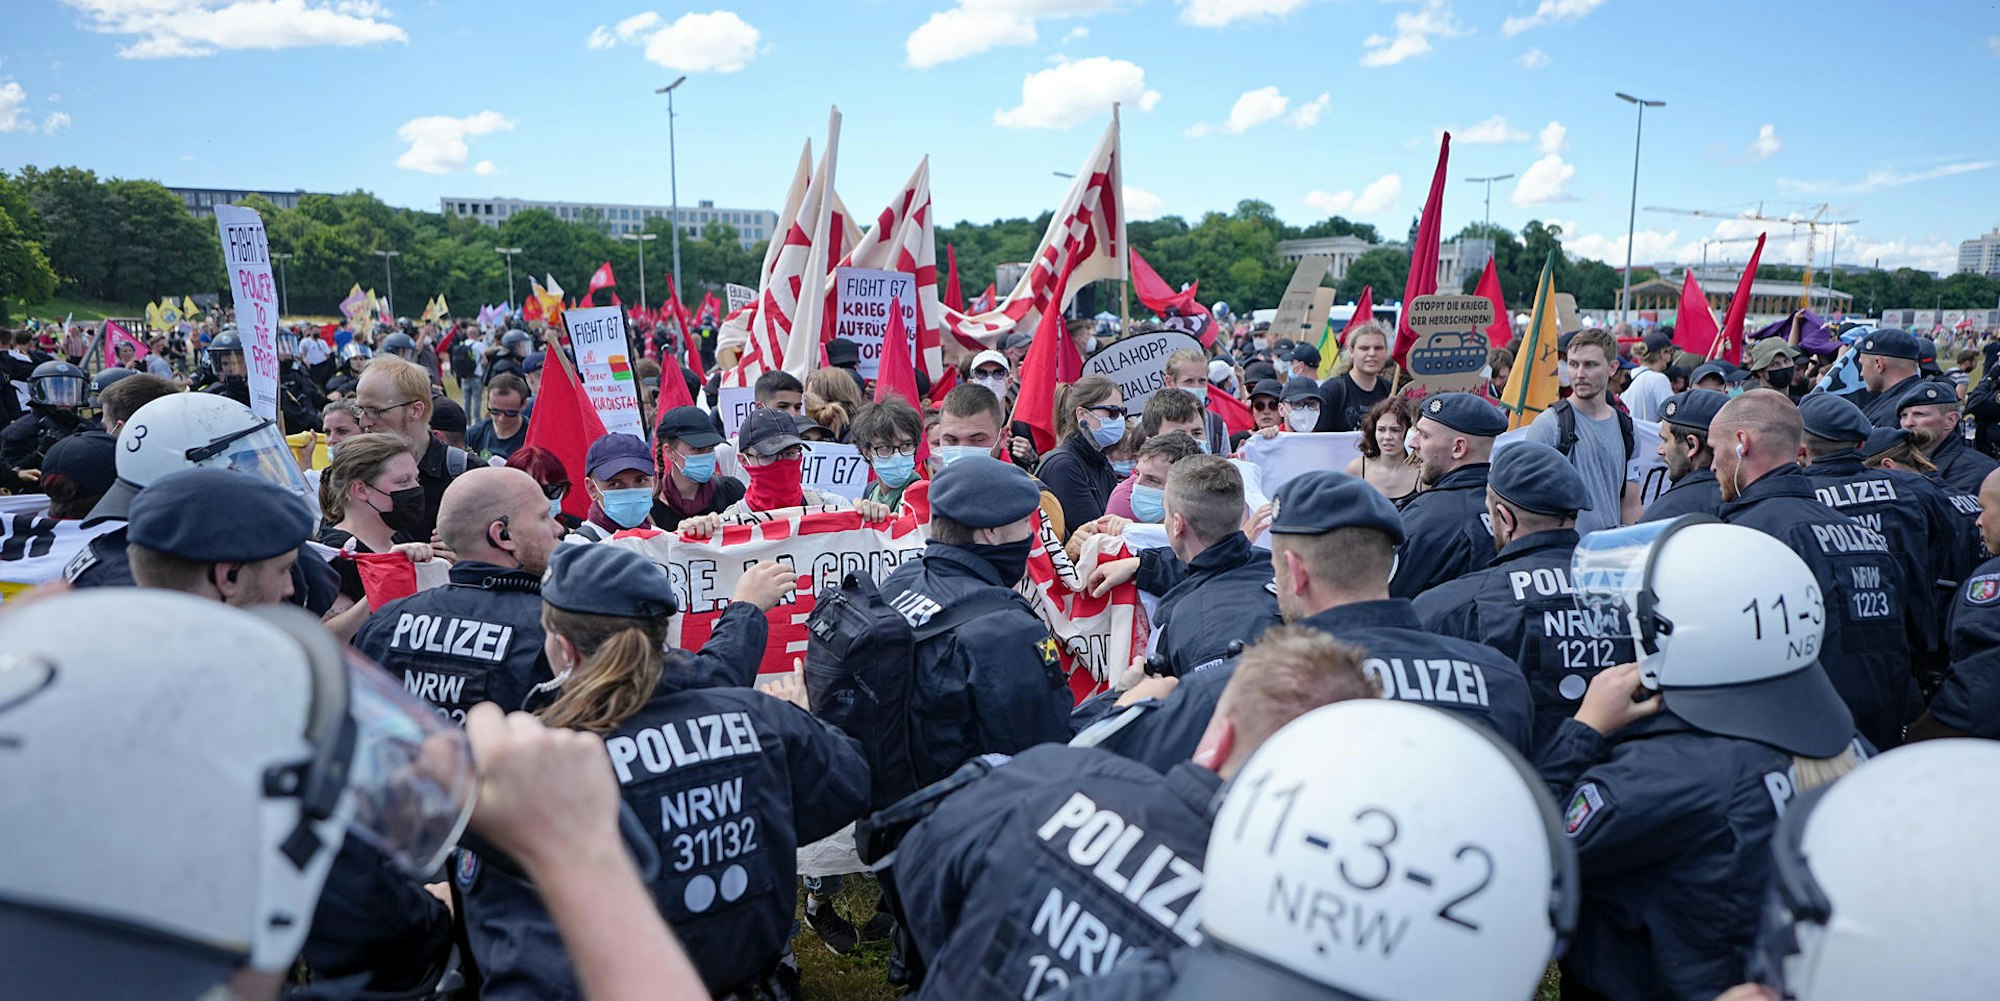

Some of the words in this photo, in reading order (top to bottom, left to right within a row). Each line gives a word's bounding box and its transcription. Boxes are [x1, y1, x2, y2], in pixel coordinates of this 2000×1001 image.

[228, 227, 258, 263] FIGHT
[239, 269, 273, 304] POWER
[847, 278, 885, 297] FIGHT
[890, 279, 907, 298] G7
[254, 303, 266, 326] TO
[843, 301, 886, 318] KRIEG
[1411, 316, 1429, 326] DER
[1428, 314, 1492, 325] HERRSCHENDEN!
[1414, 301, 1446, 311] STOPPT
[1447, 301, 1460, 311] DIE
[1461, 301, 1489, 311] KRIEGE
[254, 325, 272, 350] THE
[574, 319, 603, 346] FIGHT
[606, 316, 619, 340] G7
[833, 456, 861, 484] G7
[1851, 565, 1881, 589] NRW
[1853, 591, 1890, 618] 1223
[390, 612, 513, 662] POLIZEI
[1557, 638, 1616, 669] 1212
[403, 669, 466, 703] NRW
[1362, 657, 1490, 707] OLIZEI
[605, 712, 763, 785] POLIZEI
[659, 777, 743, 832] NRW
[672, 816, 758, 873] 31132
[1234, 768, 1495, 931] 11-3-2
[1266, 873, 1411, 951] NRW
